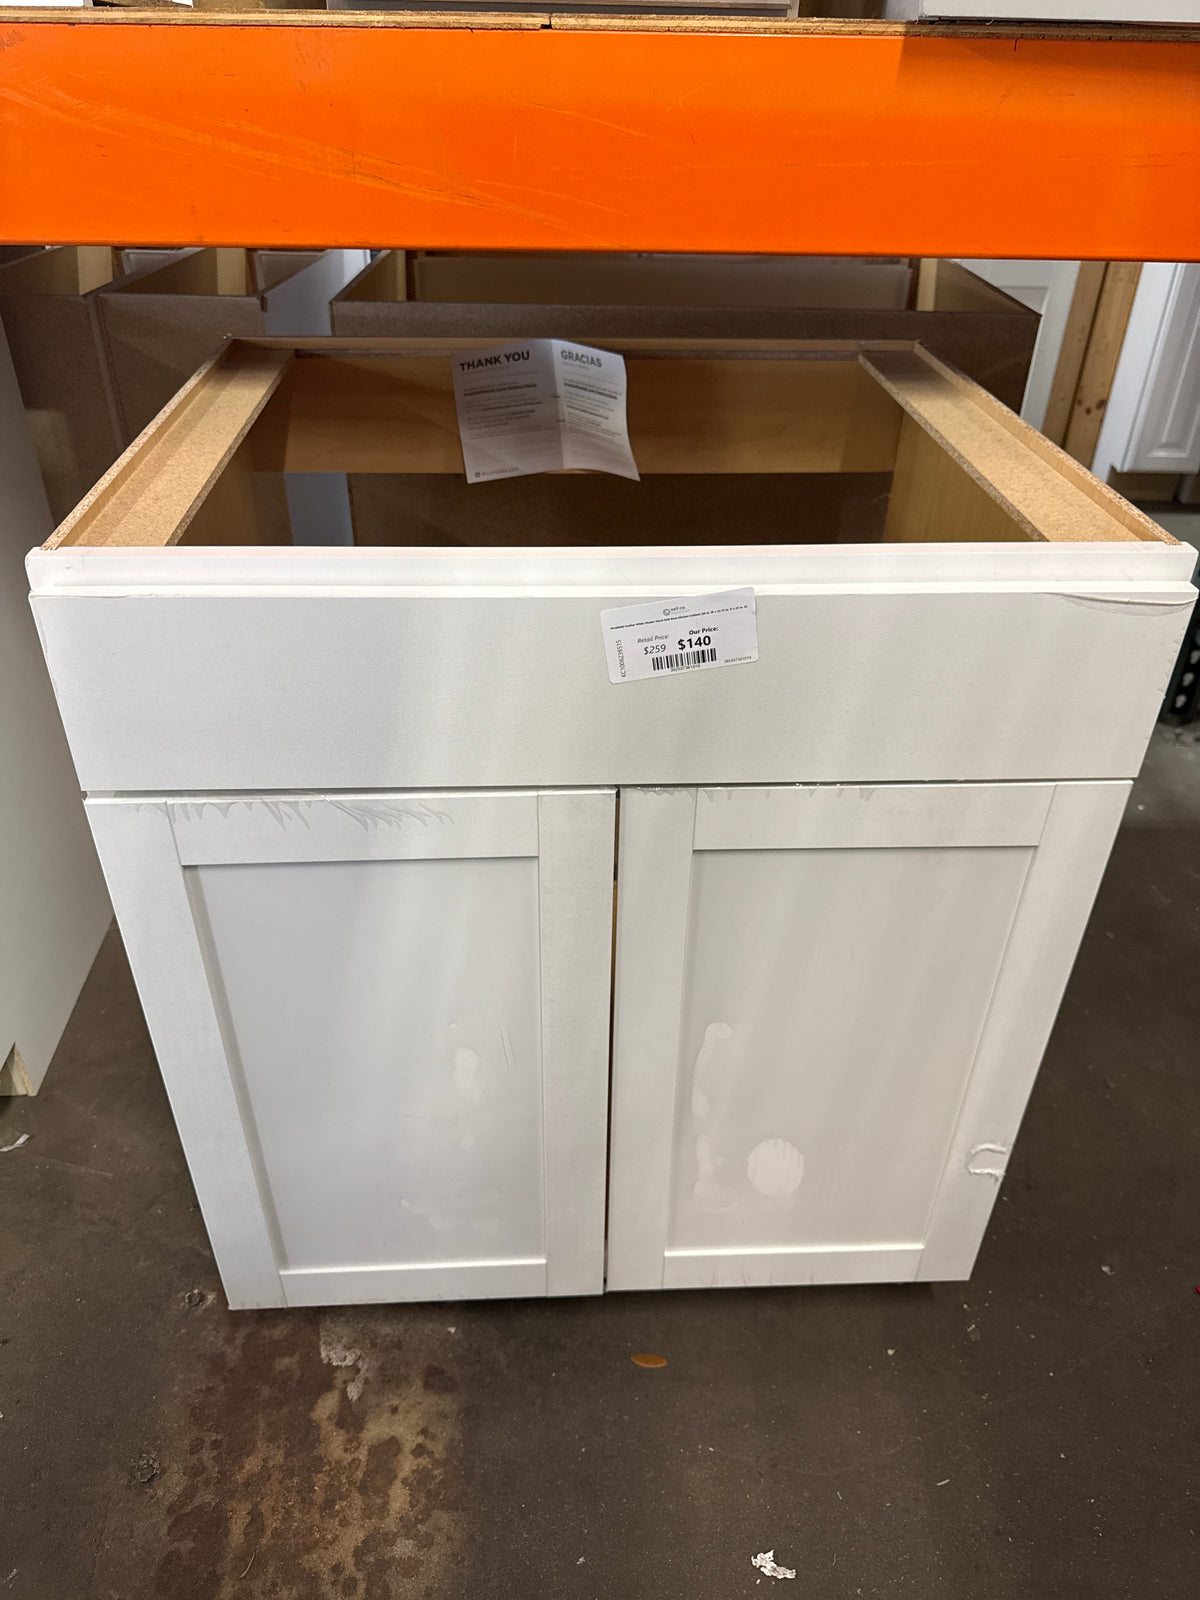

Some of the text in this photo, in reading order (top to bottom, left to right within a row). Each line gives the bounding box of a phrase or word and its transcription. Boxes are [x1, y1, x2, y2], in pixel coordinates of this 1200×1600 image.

[459, 355, 502, 372] THANK
[503, 350, 530, 363] YOU
[560, 350, 602, 368] GRACIAS
[702, 626, 719, 634] Price:
[643, 644, 667, 655] $259
[677, 635, 712, 651] $140
